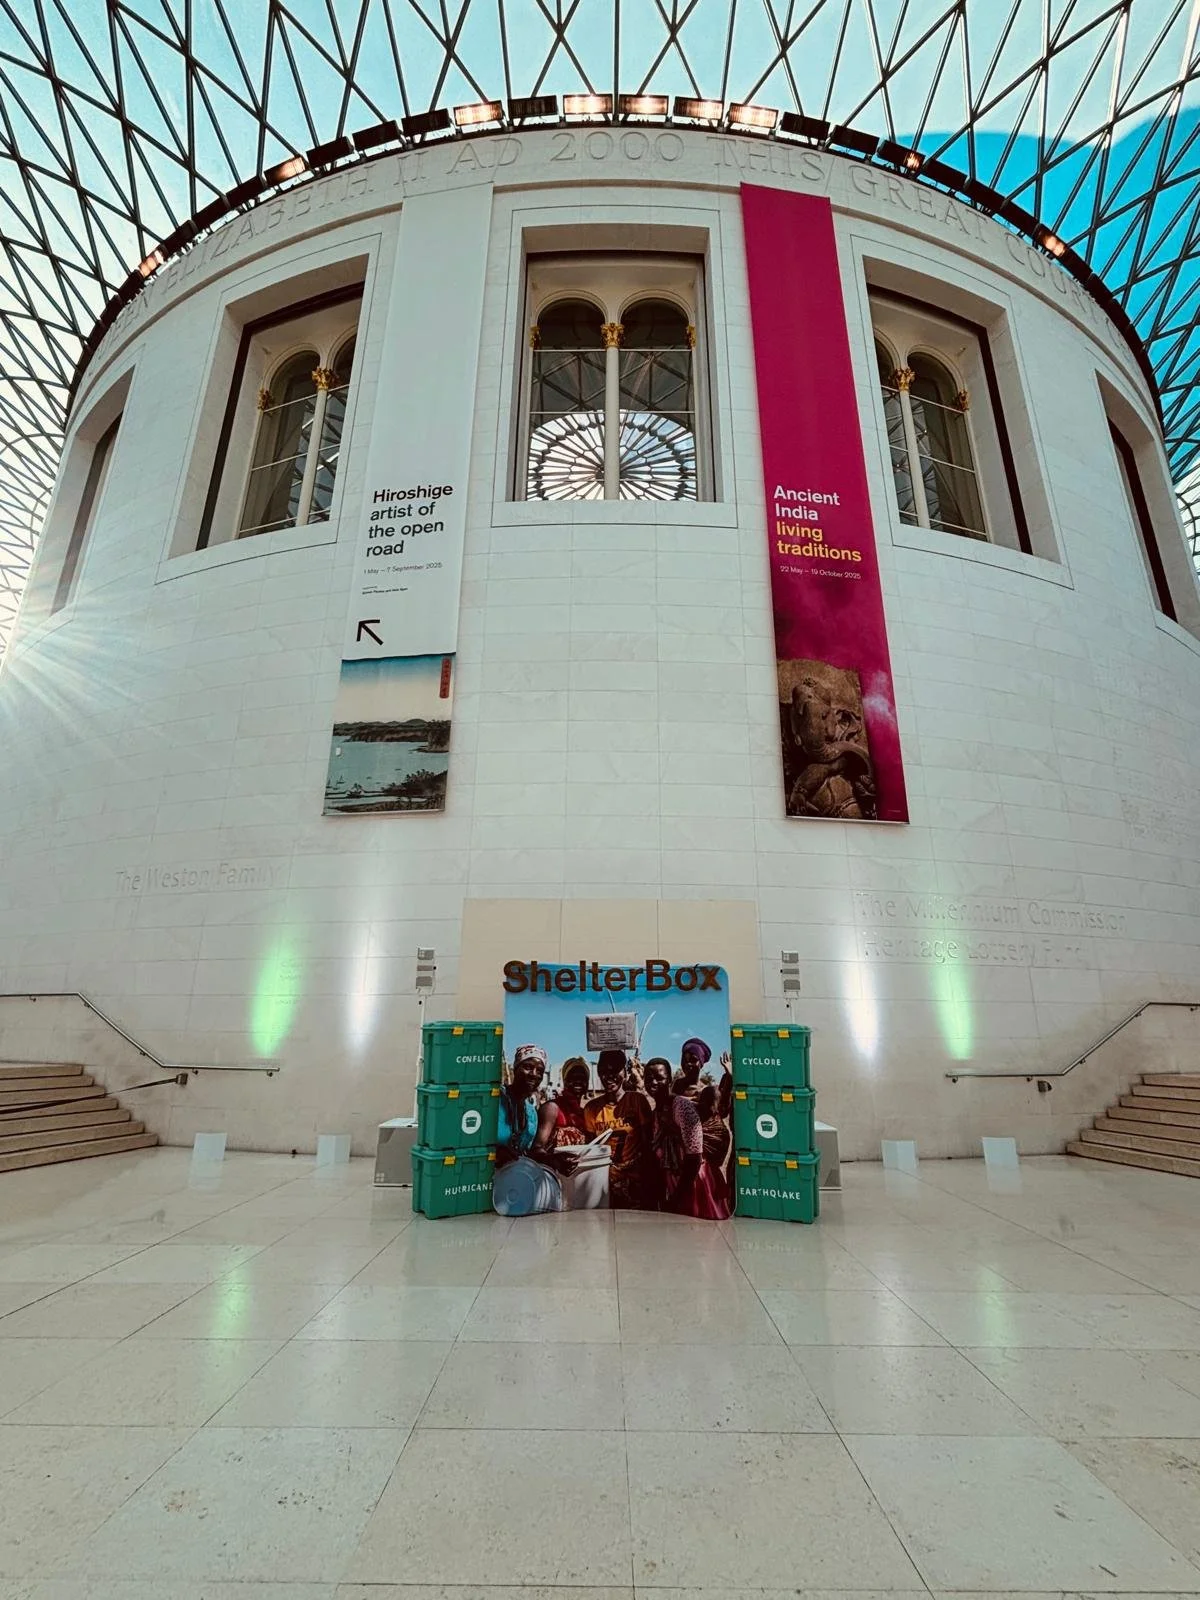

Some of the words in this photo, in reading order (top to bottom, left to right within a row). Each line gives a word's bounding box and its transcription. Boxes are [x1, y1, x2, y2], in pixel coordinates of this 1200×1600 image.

[161, 164, 376, 295] ELIZABETH
[393, 150, 430, 186] II
[446, 137, 523, 175] AD
[550, 131, 685, 162] 2000
[704, 135, 825, 182] THIS
[848, 164, 992, 244] GREAT
[373, 484, 453, 503] Hiroshige
[773, 485, 841, 506] Ancient
[370, 504, 413, 521] artist
[418, 502, 435, 516] of
[775, 503, 819, 521] India
[368, 524, 395, 539] the
[400, 521, 444, 537] open
[776, 521, 823, 542] living
[366, 540, 405, 557] road
[777, 540, 862, 562] traditions
[392, 564, 424, 573] September
[790, 566, 803, 575] May
[819, 569, 843, 578] October
[844, 571, 862, 579] 2025
[115, 870, 141, 891] The
[146, 867, 210, 889] Weston
[856, 893, 896, 917] The
[906, 896, 1018, 924] Millennium
[1028, 901, 1127, 932] Commission
[503, 960, 723, 993] ShelterBox
[455, 1055, 495, 1064] CONFLICT
